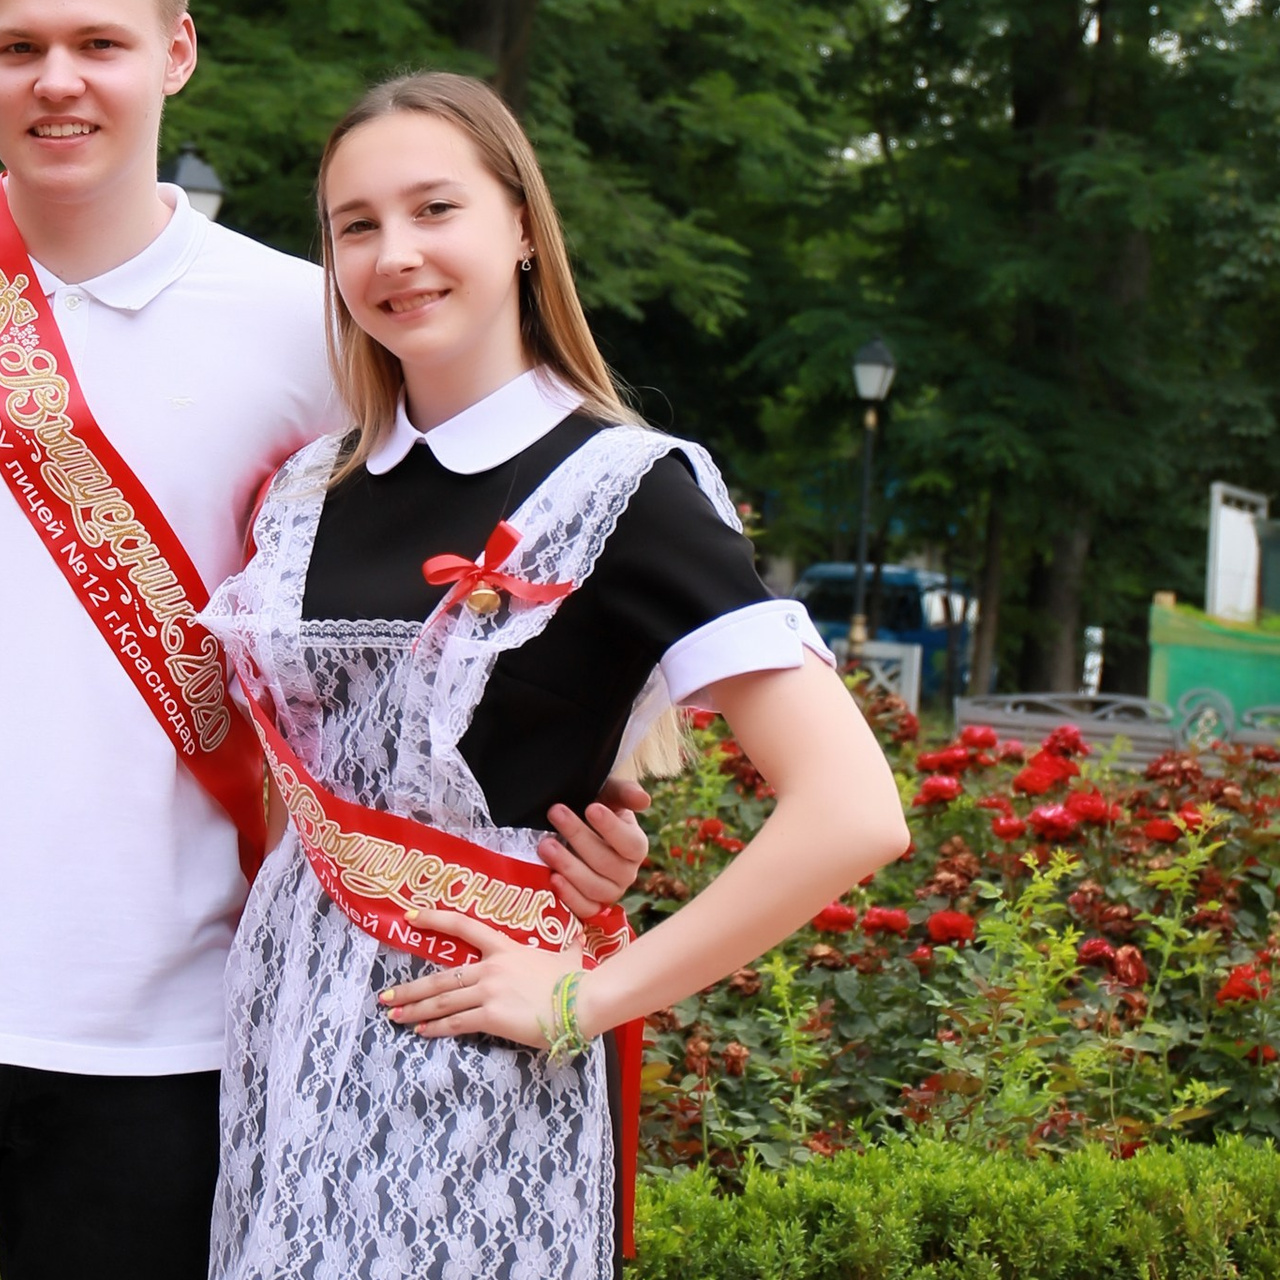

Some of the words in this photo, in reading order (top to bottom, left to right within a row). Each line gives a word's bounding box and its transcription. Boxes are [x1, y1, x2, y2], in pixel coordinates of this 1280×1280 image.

[4, 459, 67, 540] лицей
[60, 541, 110, 608] №12
[104, 610, 196, 756] г.Краснодар
[165, 633, 231, 752] 2020
[276, 762, 564, 946] Выпускник
[319, 867, 379, 934] лицей
[387, 920, 457, 962] №12
